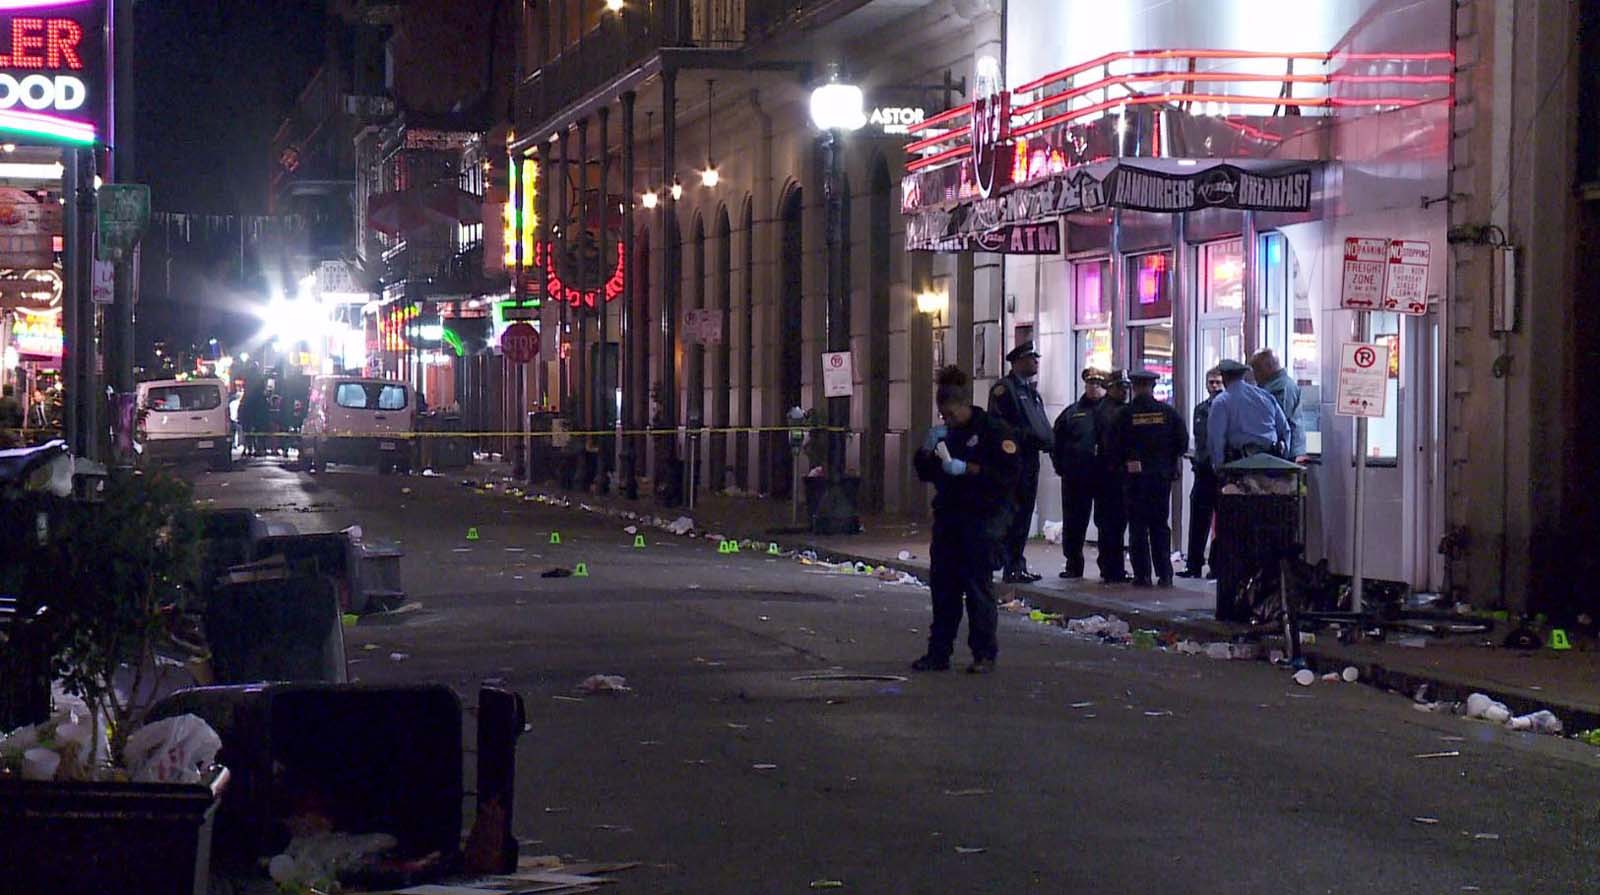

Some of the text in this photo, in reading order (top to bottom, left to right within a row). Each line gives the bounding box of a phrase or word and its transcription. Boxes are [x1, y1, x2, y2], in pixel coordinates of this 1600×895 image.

[870, 107, 925, 125] ASTOR
[1115, 169, 1195, 209] HAMBURGERS
[1238, 172, 1310, 208] BREAKFAST
[1010, 224, 1057, 252] ATM
[1345, 241, 1358, 257] NO
[1390, 244, 1402, 259] NO
[1346, 261, 1382, 274] FREIGHT
[1352, 273, 1377, 285] ZONE
[503, 335, 538, 352] STOP
